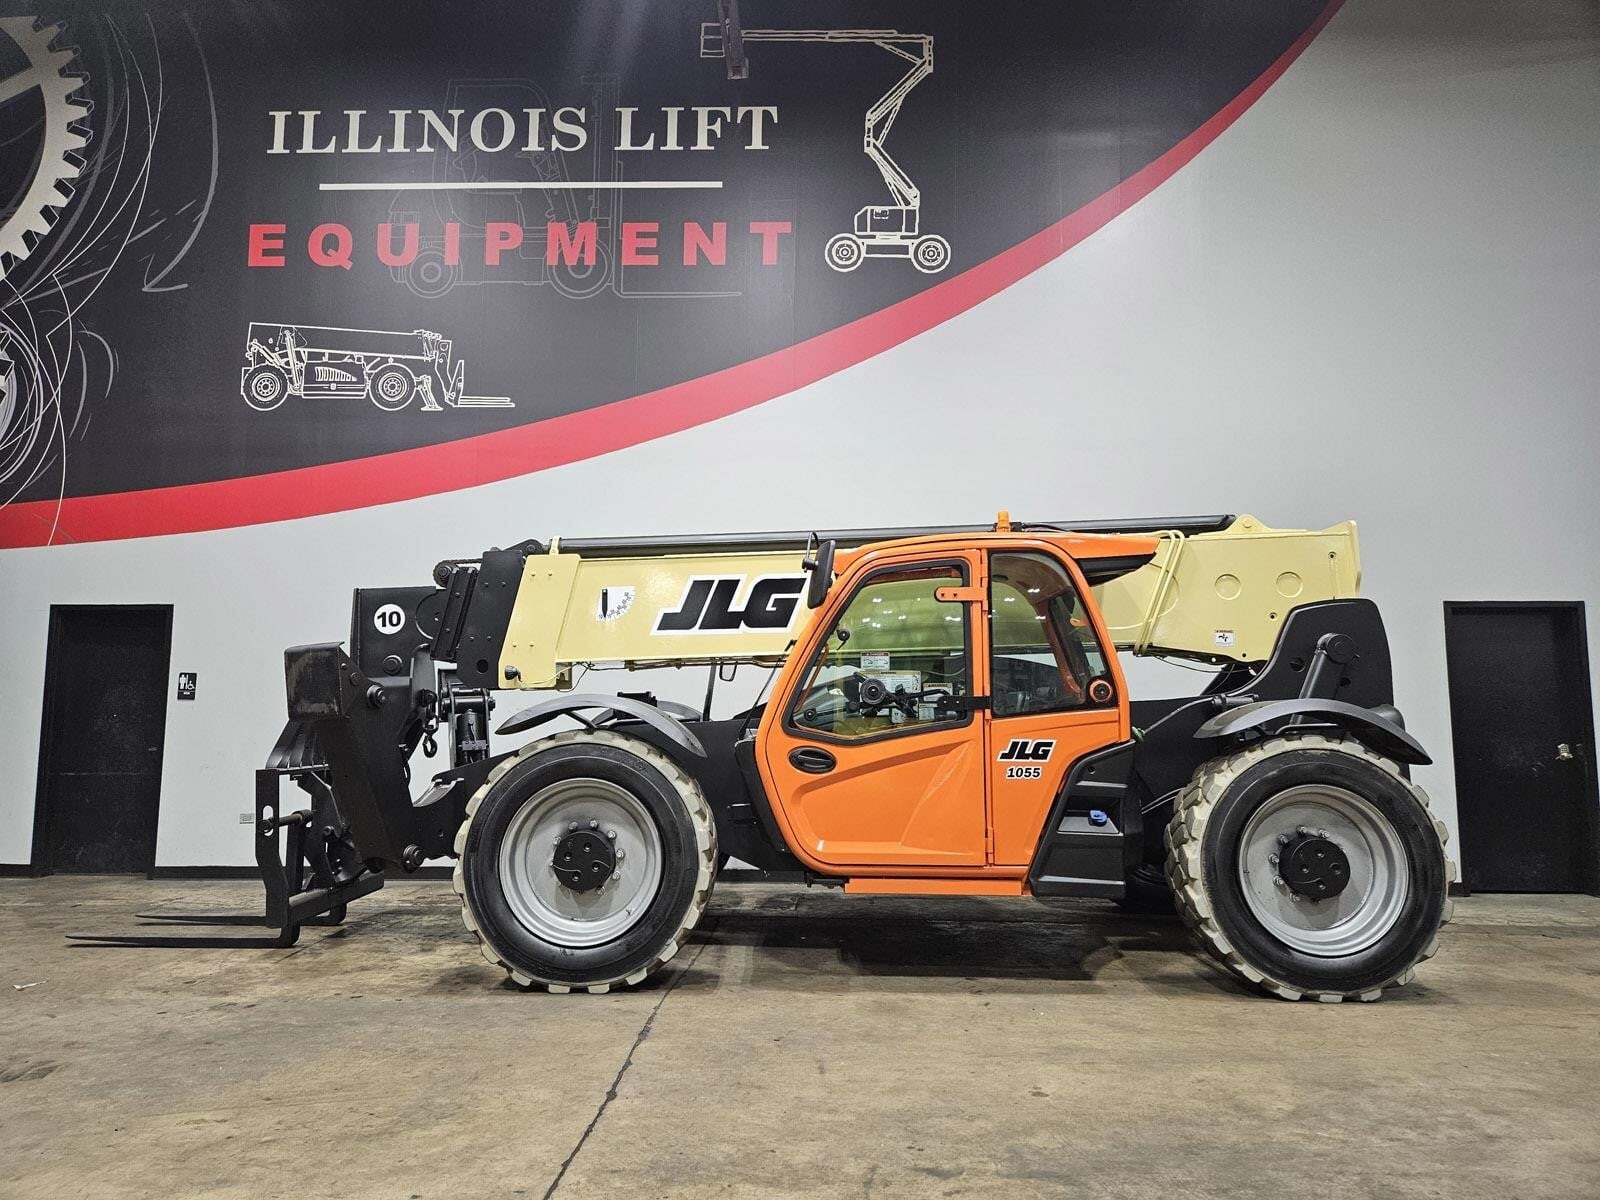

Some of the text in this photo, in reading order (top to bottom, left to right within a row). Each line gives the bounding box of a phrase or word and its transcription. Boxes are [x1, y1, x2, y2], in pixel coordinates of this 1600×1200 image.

[266, 105, 779, 155] ILLINOIS LIFT
[247, 222, 793, 270] EQUIPMENT
[377, 611, 402, 628] 10
[656, 577, 808, 631] JLG
[999, 741, 1054, 760] JLG
[1007, 767, 1041, 778] 1055
